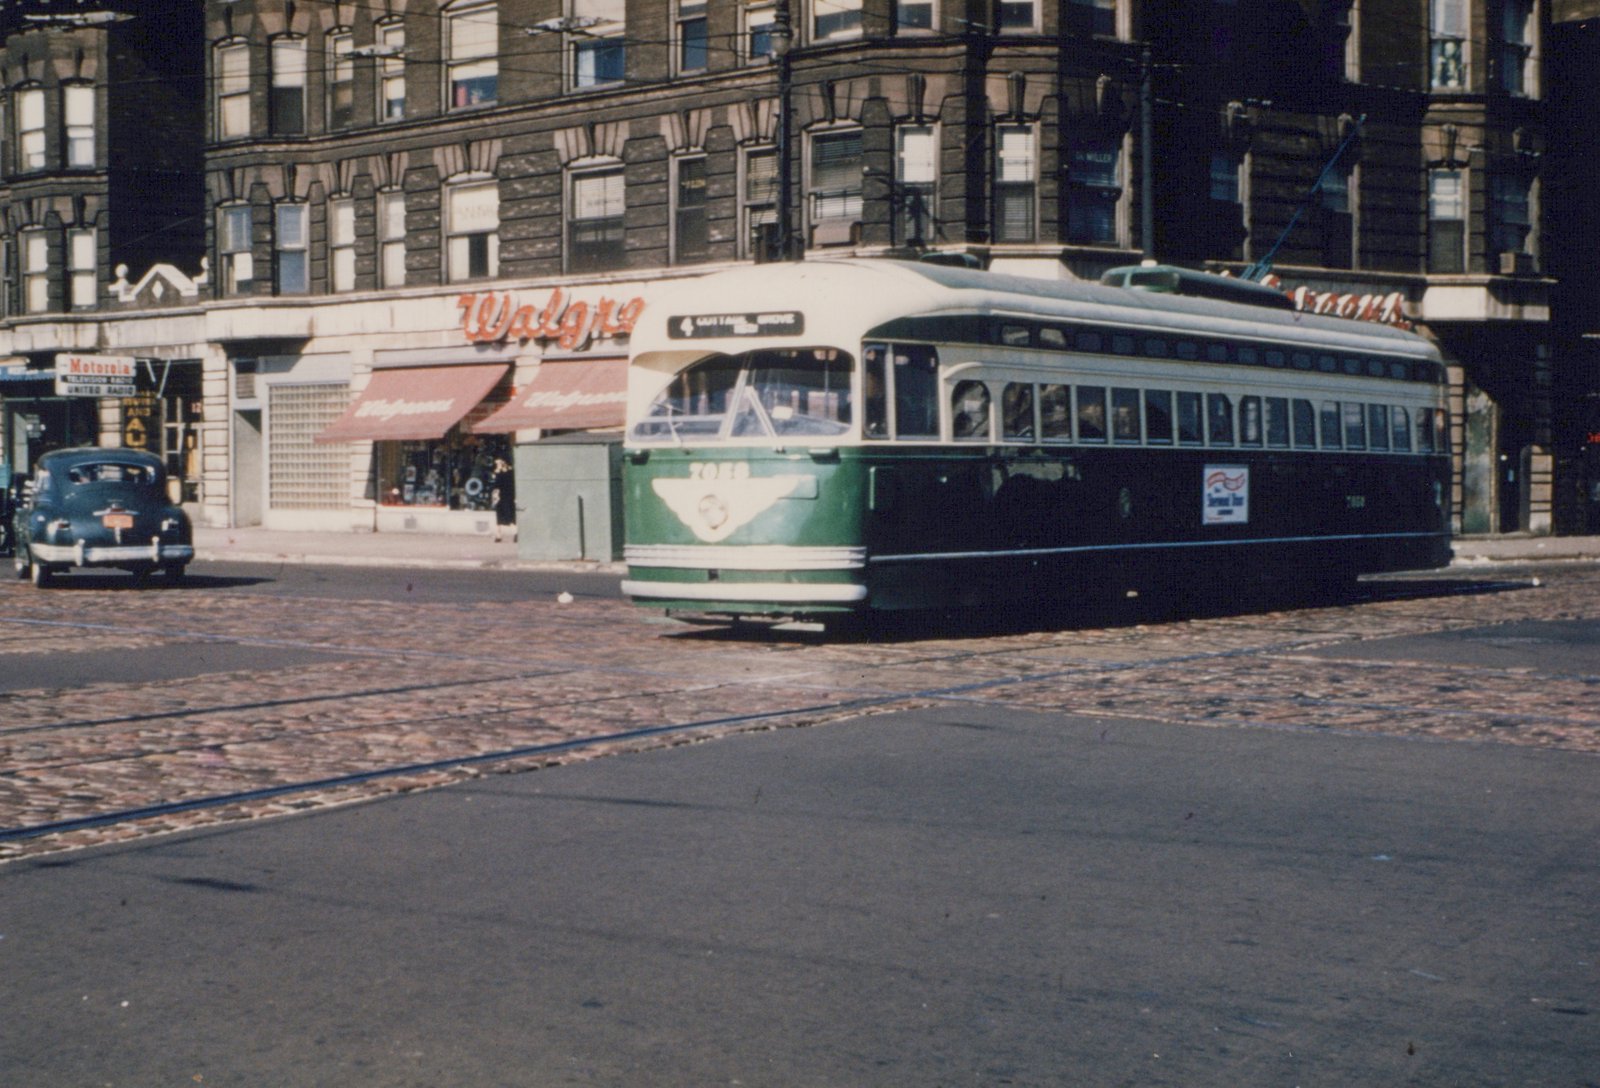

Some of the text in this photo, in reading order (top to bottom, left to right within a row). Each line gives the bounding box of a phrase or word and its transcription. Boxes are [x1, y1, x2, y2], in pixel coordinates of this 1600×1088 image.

[680, 316, 694, 337] 4
[69, 357, 131, 375] Motorola
[67, 385, 101, 395] UNITED
[107, 385, 135, 395] RADIO
